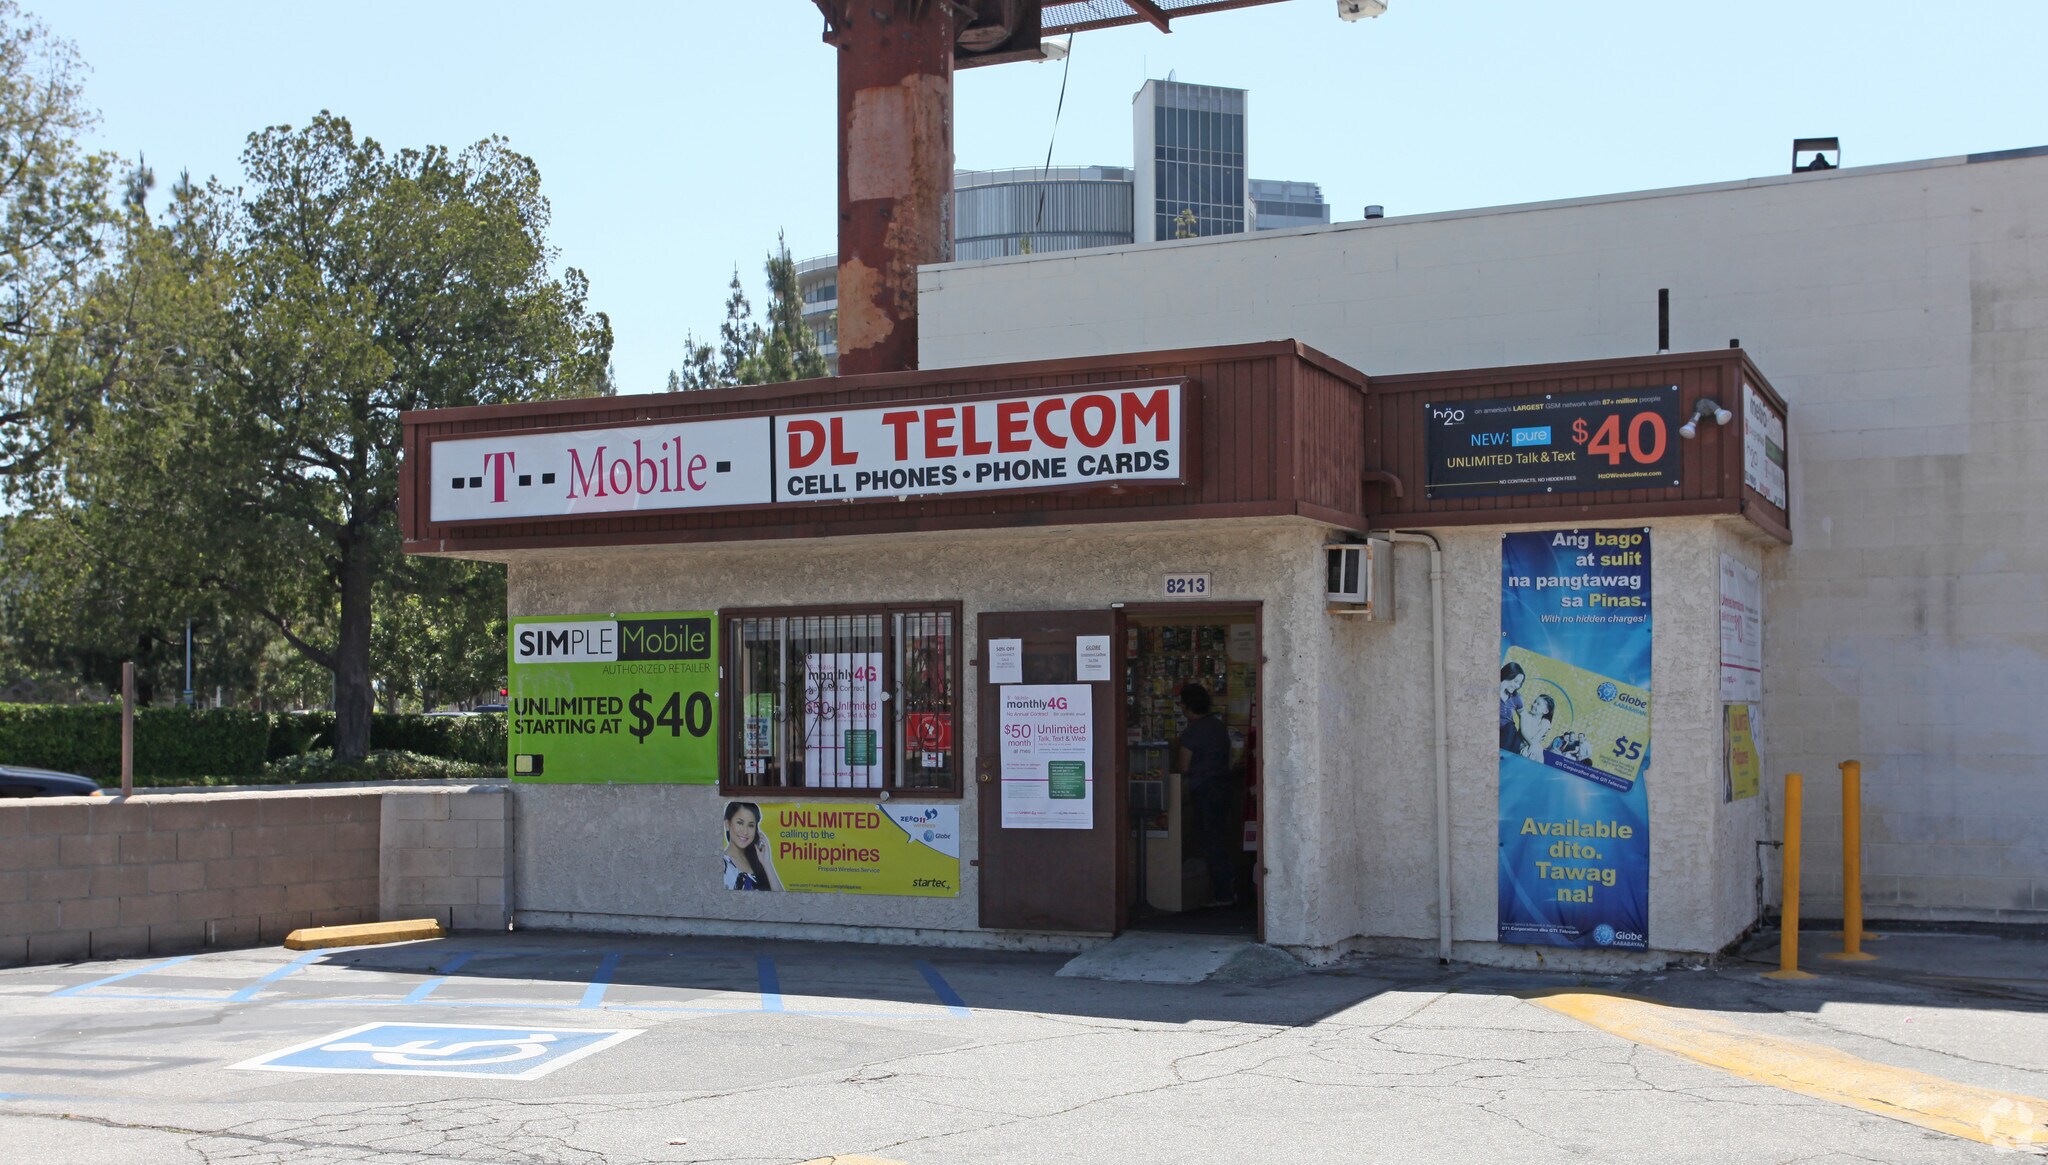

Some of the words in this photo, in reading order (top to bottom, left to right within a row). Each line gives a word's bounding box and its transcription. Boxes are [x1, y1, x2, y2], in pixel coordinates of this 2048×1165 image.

[1513, 403, 1544, 412] LARGEST
[1562, 401, 1587, 409] network
[1639, 396, 1662, 404] people
[786, 417, 859, 469] DL
[882, 389, 1171, 462] TELECOM
[1471, 432, 1509, 447] NEW:
[1515, 430, 1548, 444] pure
[1572, 411, 1667, 466] $40
[566, 436, 707, 500] Mobile
[1447, 454, 1513, 468] UNLIMITED
[1516, 452, 1539, 464] Talk
[1540, 452, 1550, 463] &
[1552, 451, 1576, 462] Text
[787, 472, 847, 497] CELL
[856, 464, 958, 491] PHONES
[975, 457, 1067, 483] PHONE
[1077, 449, 1170, 476] CARDS
[1552, 532, 1589, 549] Ang
[1594, 532, 1643, 549] bago
[1576, 552, 1595, 567] at
[1600, 552, 1642, 567] sulit
[1166, 577, 1206, 594] 8213
[1508, 576, 1531, 587] na
[1536, 573, 1642, 591] pangtawag
[1561, 596, 1583, 607] sa
[1589, 592, 1647, 607] Pinas.
[1541, 614, 1561, 623] With
[1575, 614, 1606, 623] hidden
[1607, 614, 1647, 625] charges!
[519, 628, 613, 656] SIMPLE
[622, 624, 705, 654] Mobile
[602, 664, 667, 675] AUTHORIZED
[668, 662, 711, 674] RETAILER
[514, 696, 624, 716] UNLIMITED
[1618, 692, 1647, 710] Globe
[628, 688, 713, 744] $40
[514, 718, 596, 735] STARTING
[600, 718, 623, 735] AT
[1004, 724, 1032, 739] $50
[1037, 724, 1086, 734] Unlimited
[1008, 739, 1031, 747] month
[1612, 736, 1643, 761] $5
[779, 810, 881, 830] UNLIMITED
[1520, 817, 1633, 839] Available
[779, 830, 809, 841] calling
[810, 831, 819, 840] to
[821, 830, 835, 840] the
[779, 841, 881, 866] Philippines
[1548, 840, 1602, 860] dito.
[818, 866, 838, 874] Prepaid
[1536, 861, 1617, 887] Tawag
[912, 878, 947, 888] startec
[1557, 885, 1594, 903] na!
[1615, 931, 1643, 941] Globe
